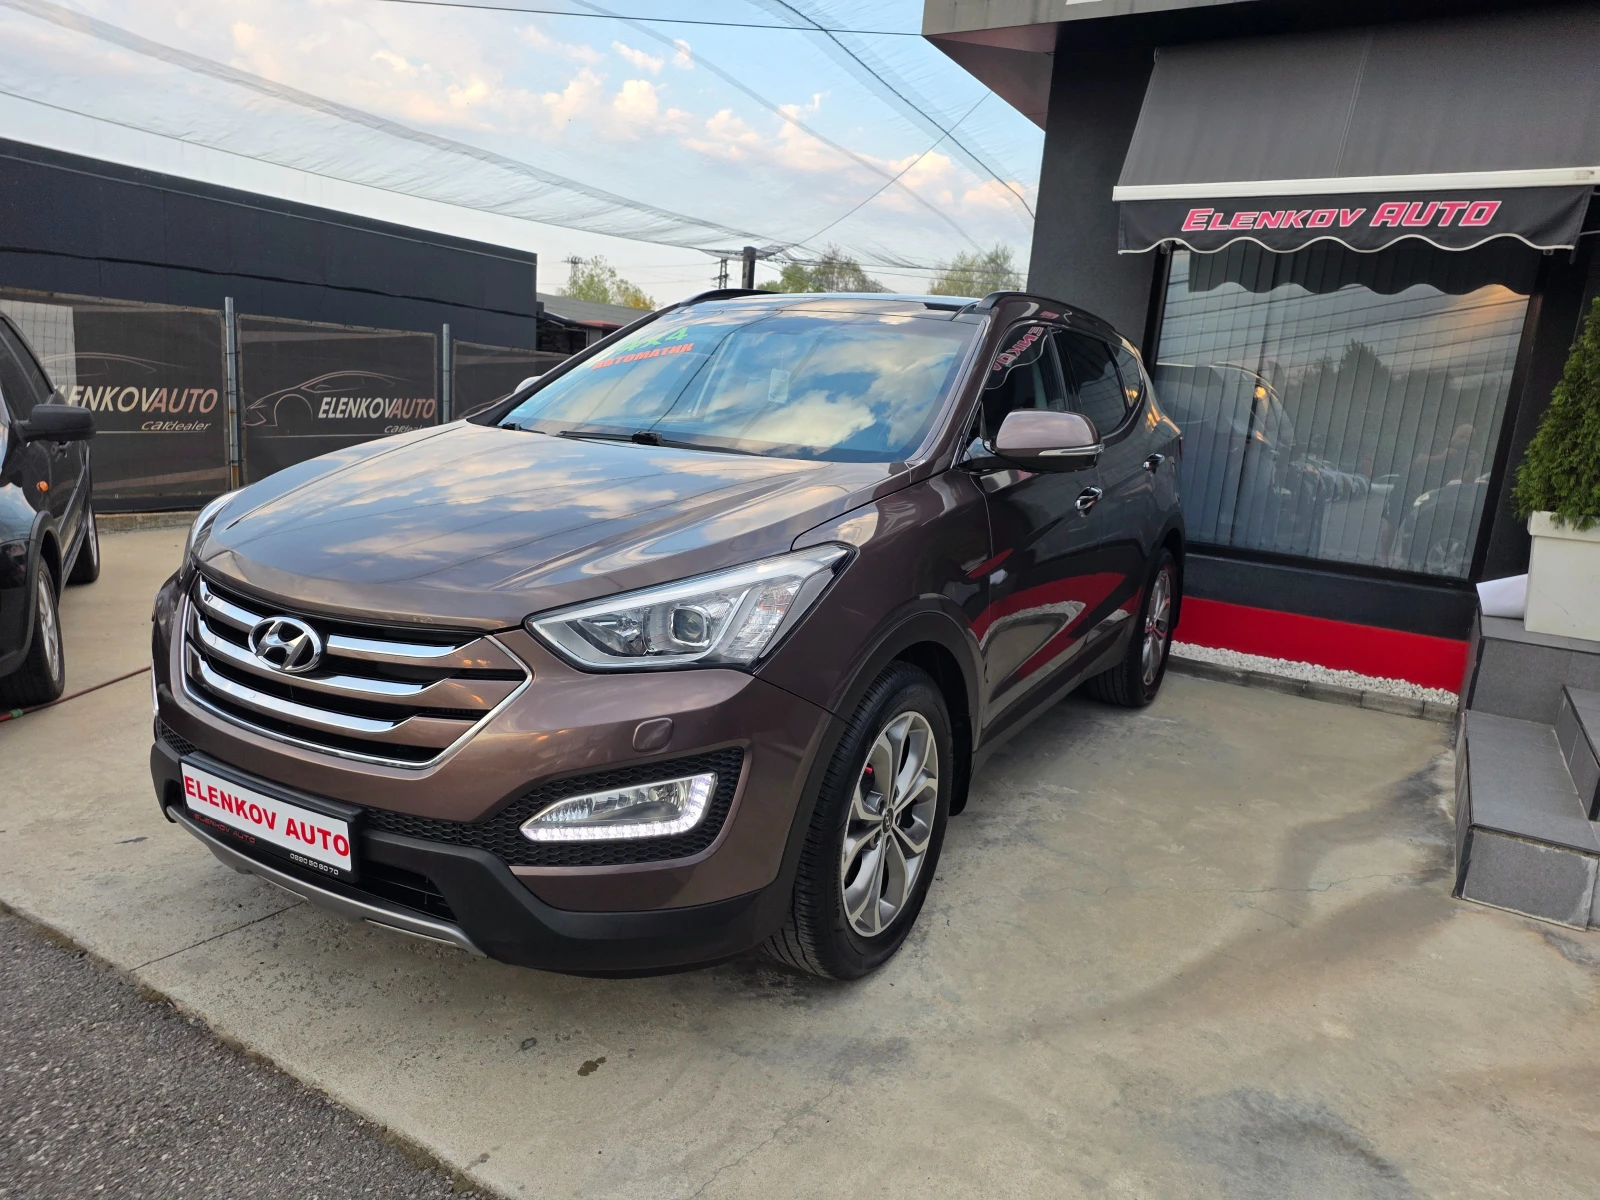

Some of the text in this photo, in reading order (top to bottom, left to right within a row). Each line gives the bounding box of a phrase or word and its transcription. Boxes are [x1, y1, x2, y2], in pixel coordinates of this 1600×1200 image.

[1369, 200, 1502, 227] AUTO
[592, 343, 695, 370] АВТОМАТИК
[318, 397, 436, 419] ELENKOVAUTO
[184, 775, 349, 857] ELENKOV AUTO
[232, 830, 256, 844] AUTO
[329, 867, 339, 875] 70
